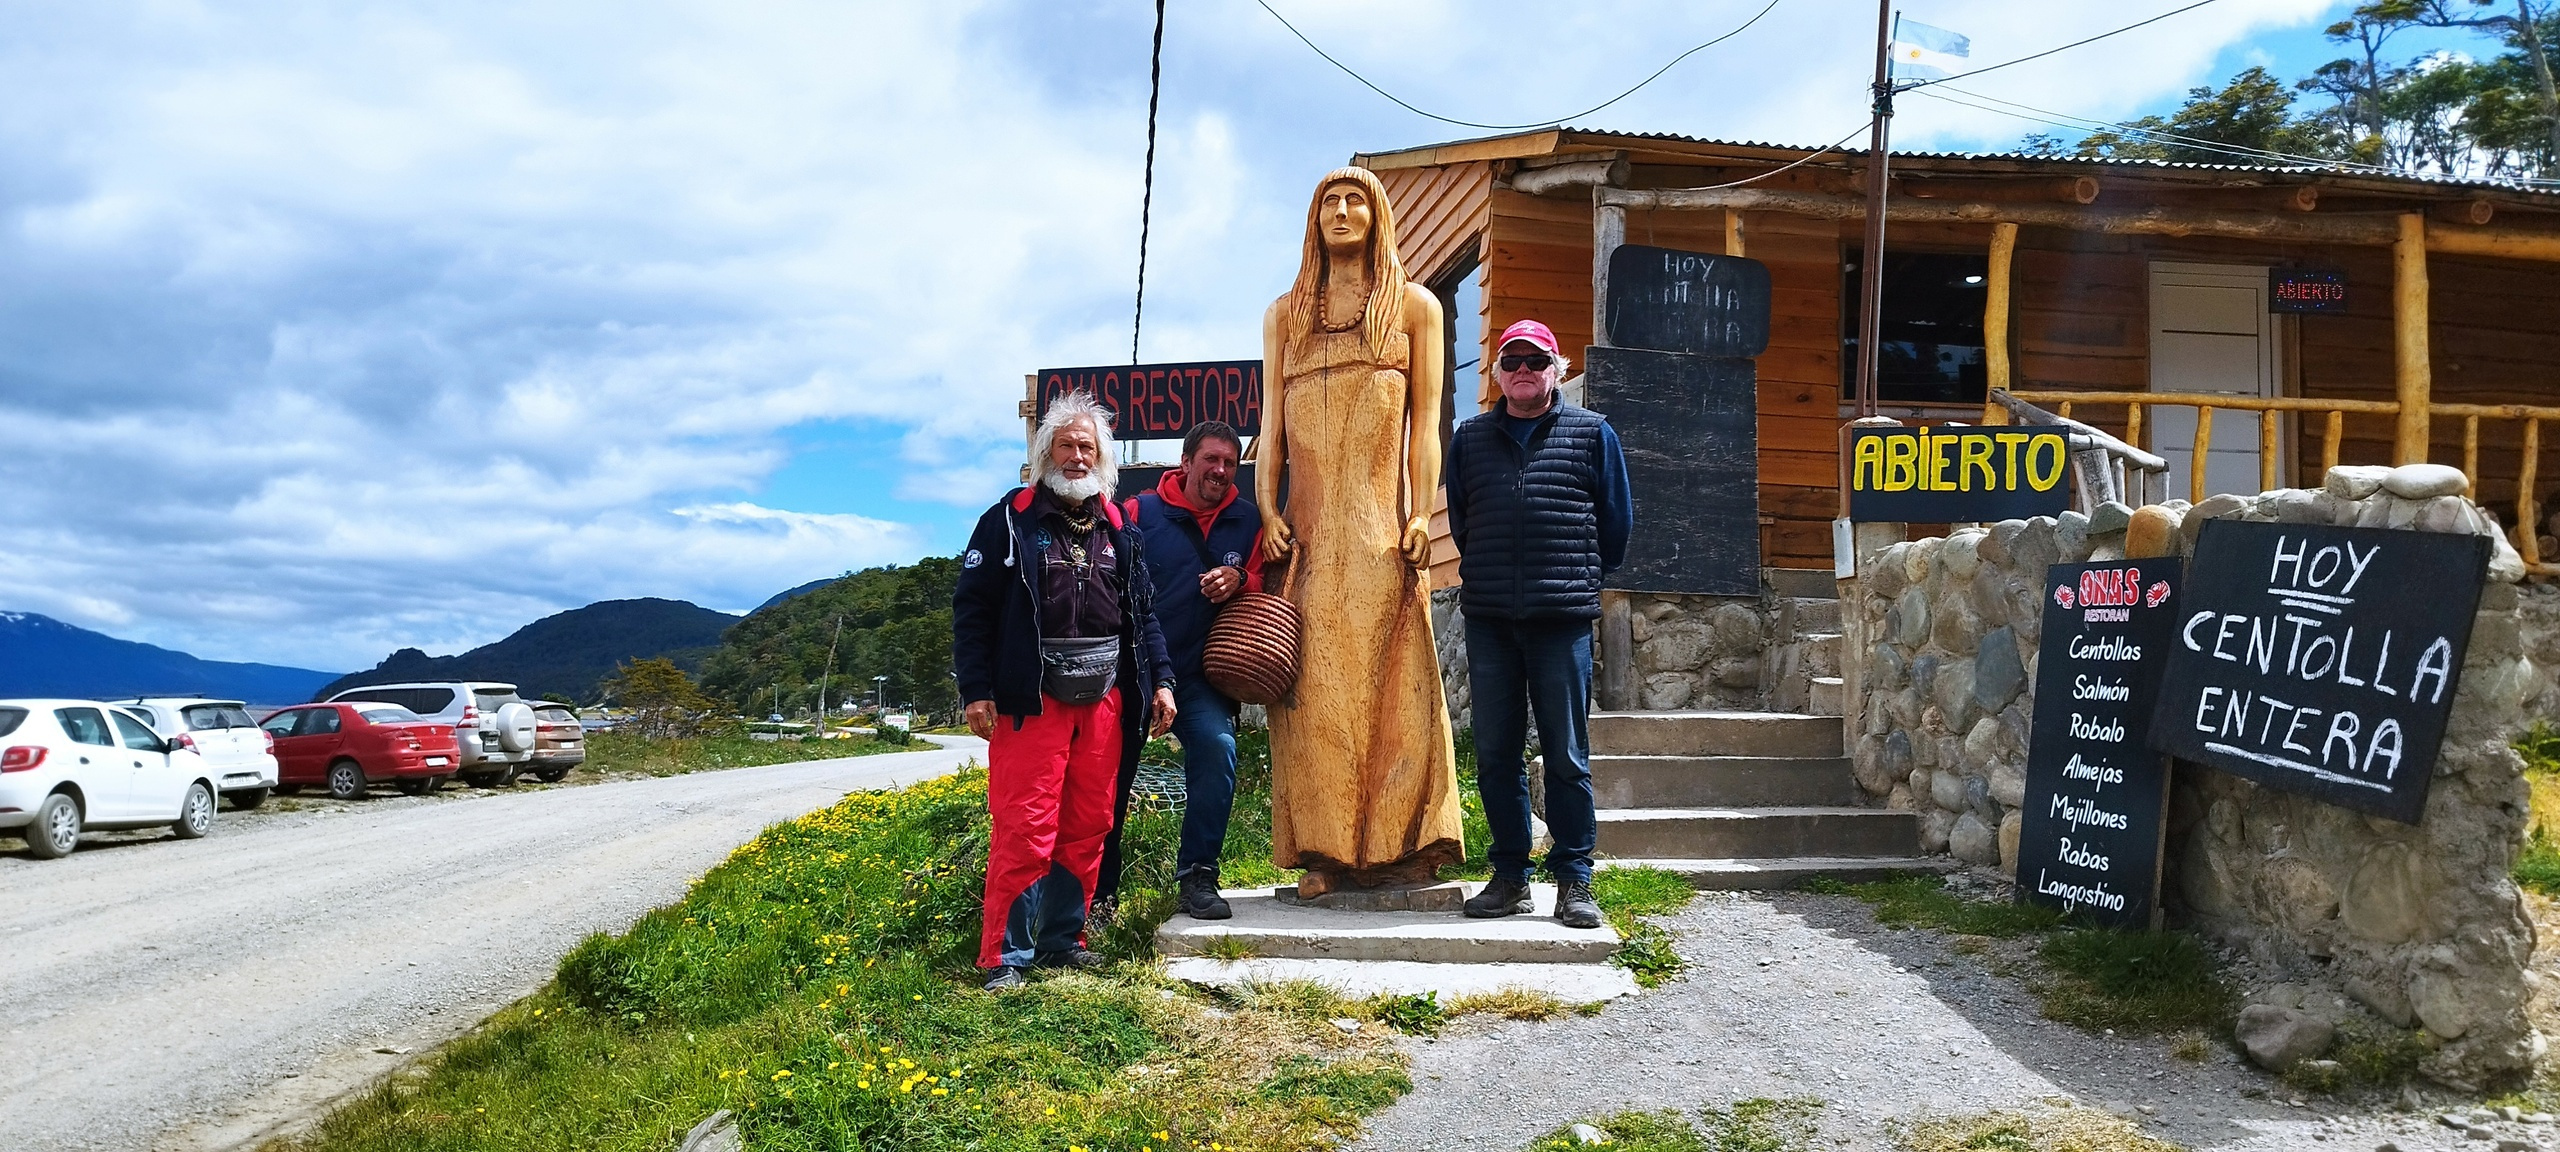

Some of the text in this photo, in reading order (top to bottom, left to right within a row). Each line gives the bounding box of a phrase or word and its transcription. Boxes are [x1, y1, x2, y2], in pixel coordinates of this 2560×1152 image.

[1664, 253, 1715, 282] HOY
[2276, 283, 2343, 300] ABIERTO
[1853, 426, 2066, 492] ABIERTO
[2270, 535, 2380, 594] HOY
[2078, 568, 2140, 607] ONAS
[2083, 609, 2130, 622] RESTORAN
[2069, 634, 2142, 661] Centollas
[2182, 610, 2453, 703] CENTOLLA
[2072, 674, 2130, 702] Salmón
[2069, 712, 2125, 742] Robalo
[2196, 686, 2403, 780] ENTERA
[2062, 753, 2124, 793] Almejas
[2050, 792, 2128, 833] Mejillones
[2058, 837, 2109, 871] Rabas
[2038, 868, 2125, 913] Langostino
